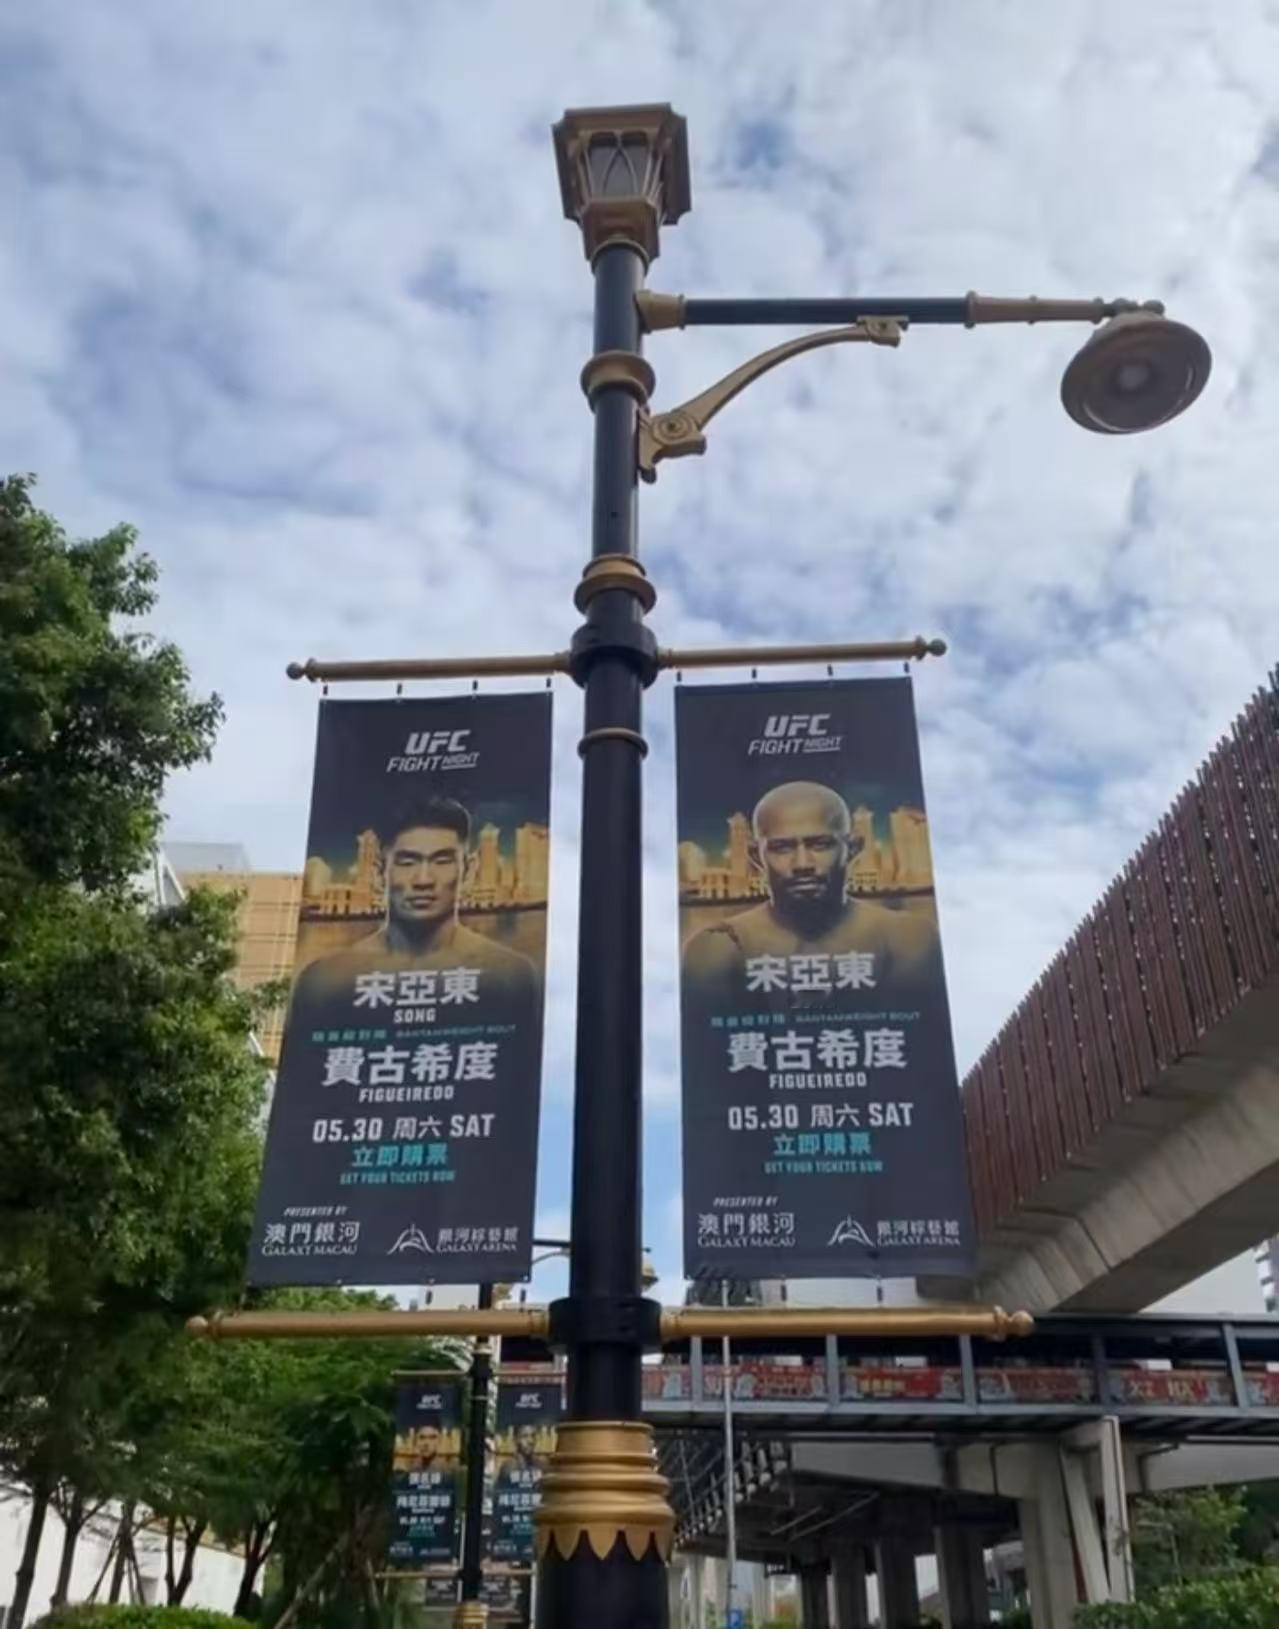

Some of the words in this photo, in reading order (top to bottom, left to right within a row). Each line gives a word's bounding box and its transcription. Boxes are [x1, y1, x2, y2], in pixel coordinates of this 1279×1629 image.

[764, 713, 831, 737] UFC
[405, 730, 471, 755] UFC
[748, 738, 804, 756] FIGHT
[802, 736, 843, 749] NIGHT
[386, 756, 443, 773] FIGHT
[441, 752, 480, 767] NIGHT
[746, 951, 877, 992] 宋亞東
[353, 967, 481, 1008] 宋亞東
[393, 1008, 436, 1023] SONG
[728, 1029, 907, 1072] 費古希度
[321, 1042, 498, 1086] 費古希度
[769, 1072, 867, 1089] FIGUEIREDO
[359, 1086, 454, 1103] FIGUEIREDO
[728, 1104, 799, 1130] 05.30
[811, 1103, 860, 1128] 周六
[868, 1102, 914, 1127] SAT
[312, 1117, 383, 1142] 05.30
[393, 1116, 443, 1139] 周六
[450, 1114, 495, 1138] SAT
[264, 1221, 361, 1244] 澳門銀河
[698, 1212, 795, 1235] 澳門銀河
[262, 1243, 312, 1257] GALAXY
[313, 1243, 359, 1256] MACAU
[698, 1235, 751, 1248] GALAXY
[751, 1235, 796, 1247] MACAU
